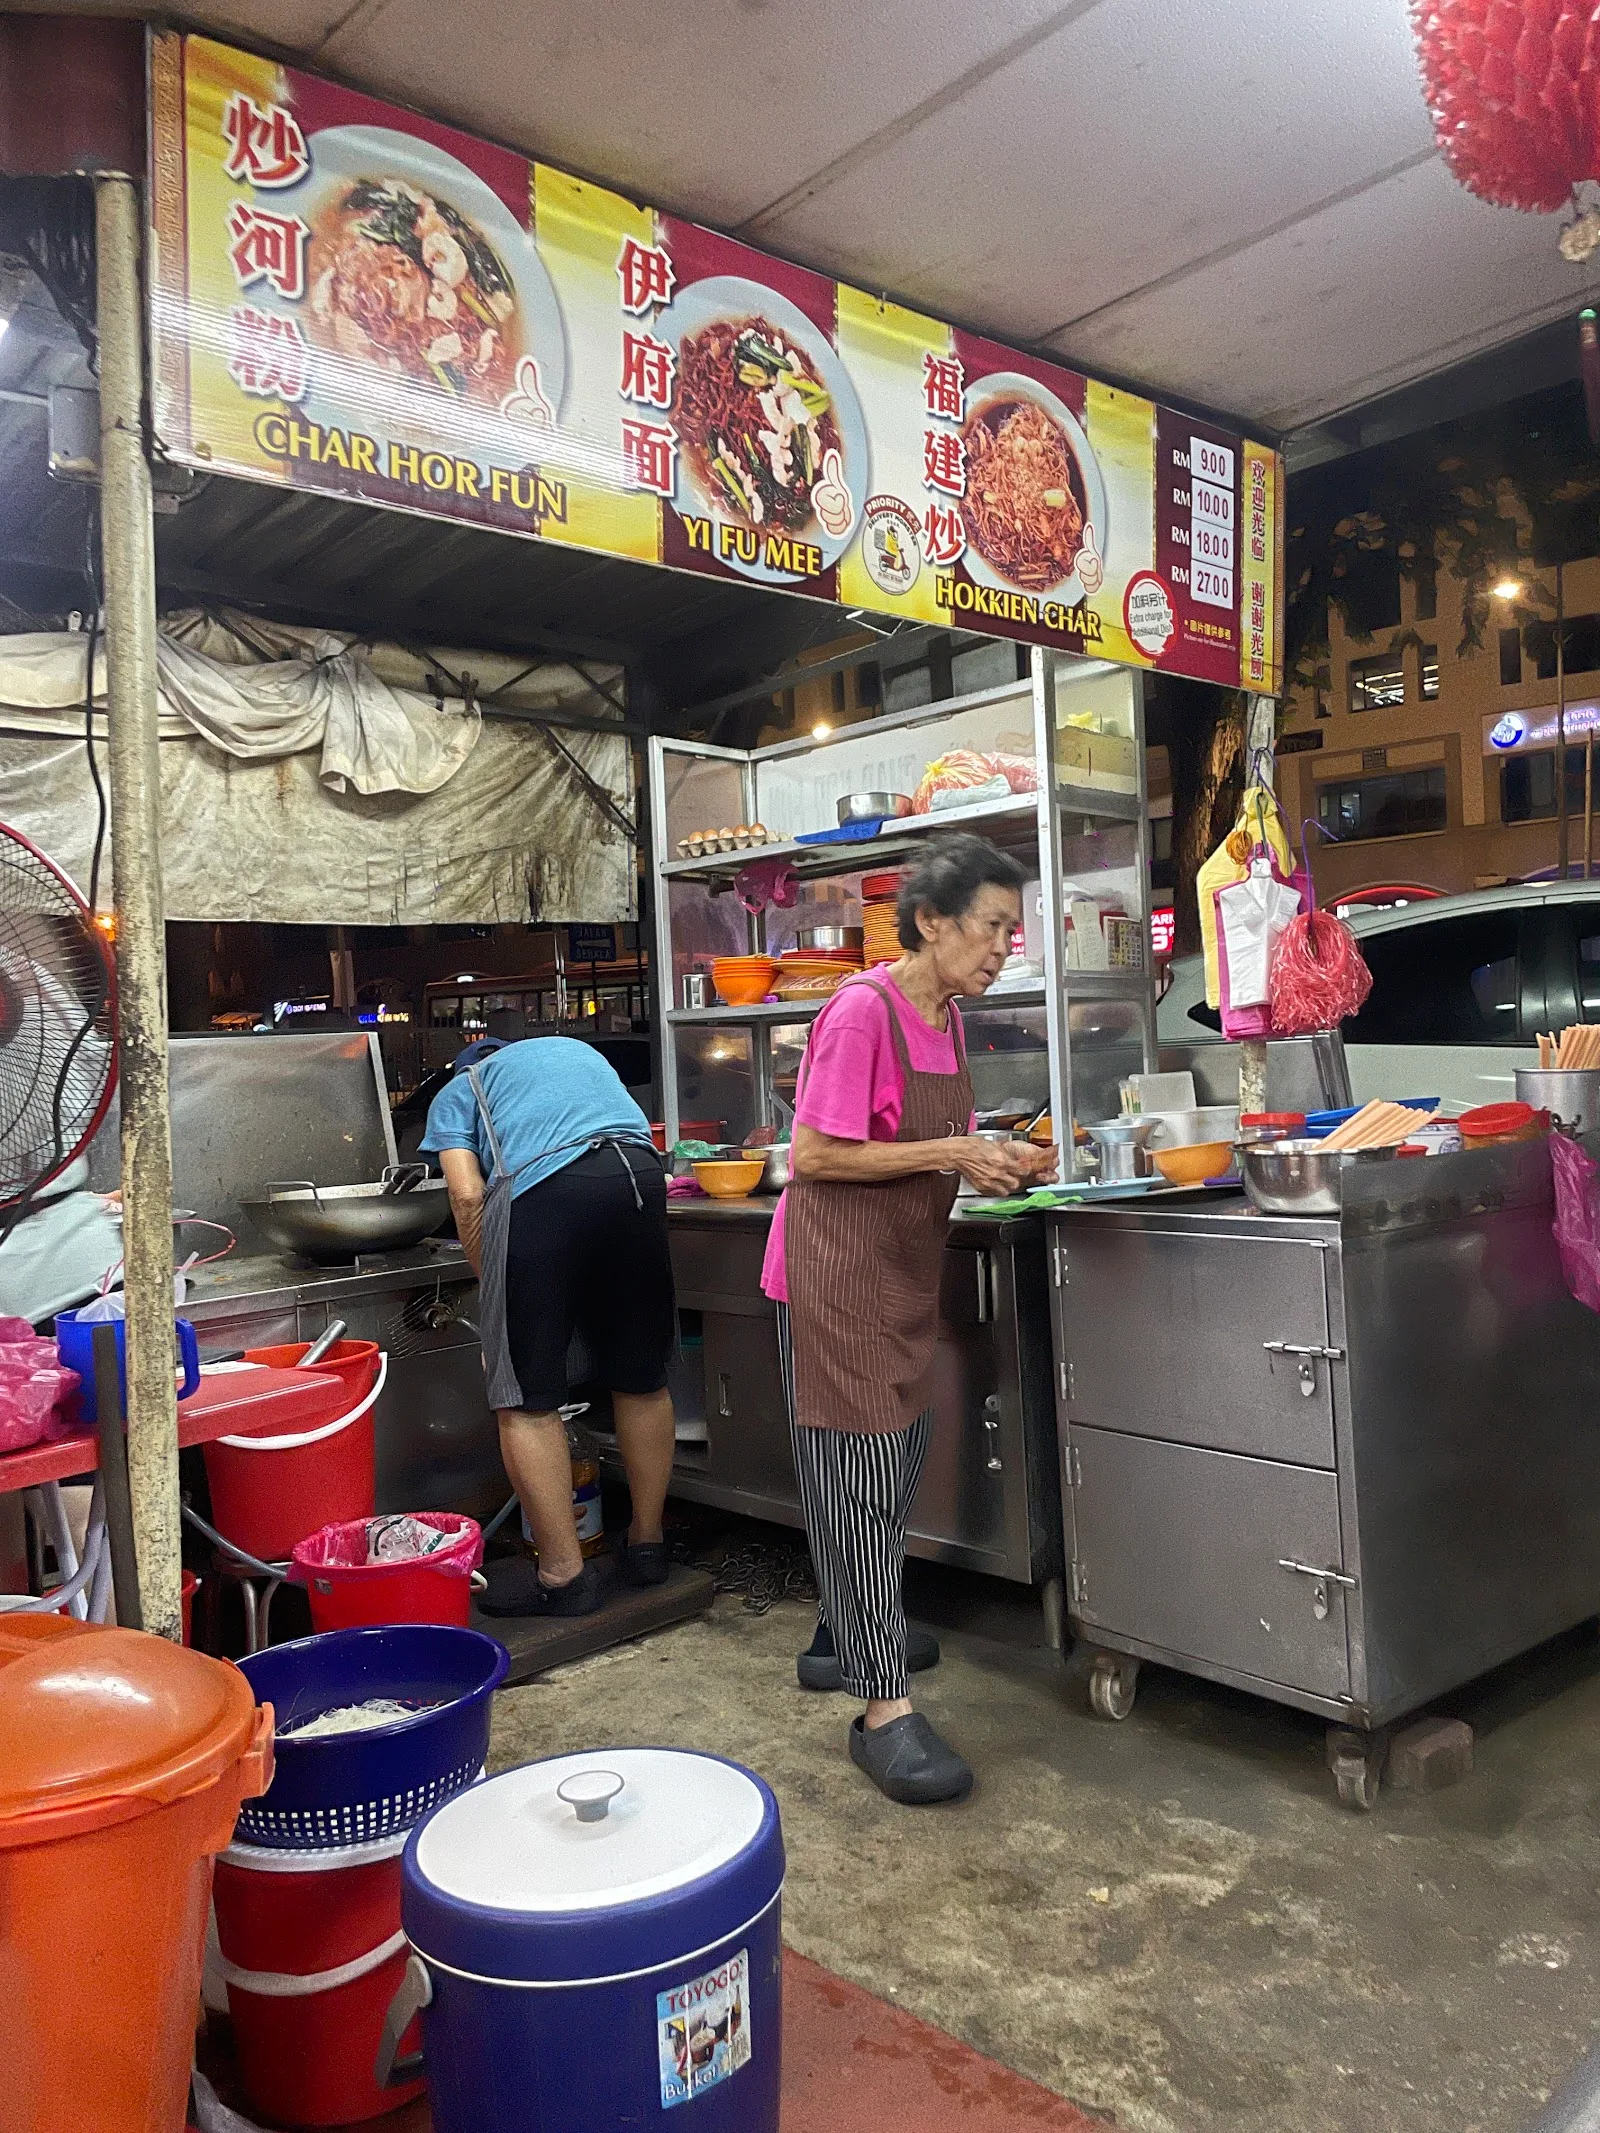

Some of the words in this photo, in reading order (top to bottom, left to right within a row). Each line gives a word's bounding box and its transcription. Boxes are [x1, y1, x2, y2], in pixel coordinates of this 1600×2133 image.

[225, 94, 308, 402] 炒河粉
[618, 237, 676, 495] 伊府面
[256, 415, 376, 474] CHAR
[389, 445, 480, 499] HOR
[491, 471, 566, 520] FUN
[924, 355, 965, 564] 福建炒
[1173, 449, 1190, 469] RM
[1200, 448, 1226, 477] 9.00
[866, 497, 906, 514] PRIORITY
[868, 512, 893, 530] DELIVERY
[1173, 487, 1191, 507] RM
[1197, 488, 1229, 520] 10.00
[1251, 460, 1265, 560] 欢迎光临
[683, 515, 711, 551] YI
[722, 523, 757, 561] FU
[766, 538, 824, 577] MEE
[1171, 526, 1190, 546] RM
[1196, 531, 1229, 559] 18.00
[1171, 565, 1190, 585] RM
[1197, 571, 1229, 599] 27.00
[936, 577, 1037, 626] HOKKIEN
[1044, 604, 1102, 640] CHAR
[1130, 613, 1144, 624] Extra
[1145, 612, 1163, 622] charge
[1132, 625, 1159, 637] Additional
[666, 1961, 741, 2013] TOYOGO
